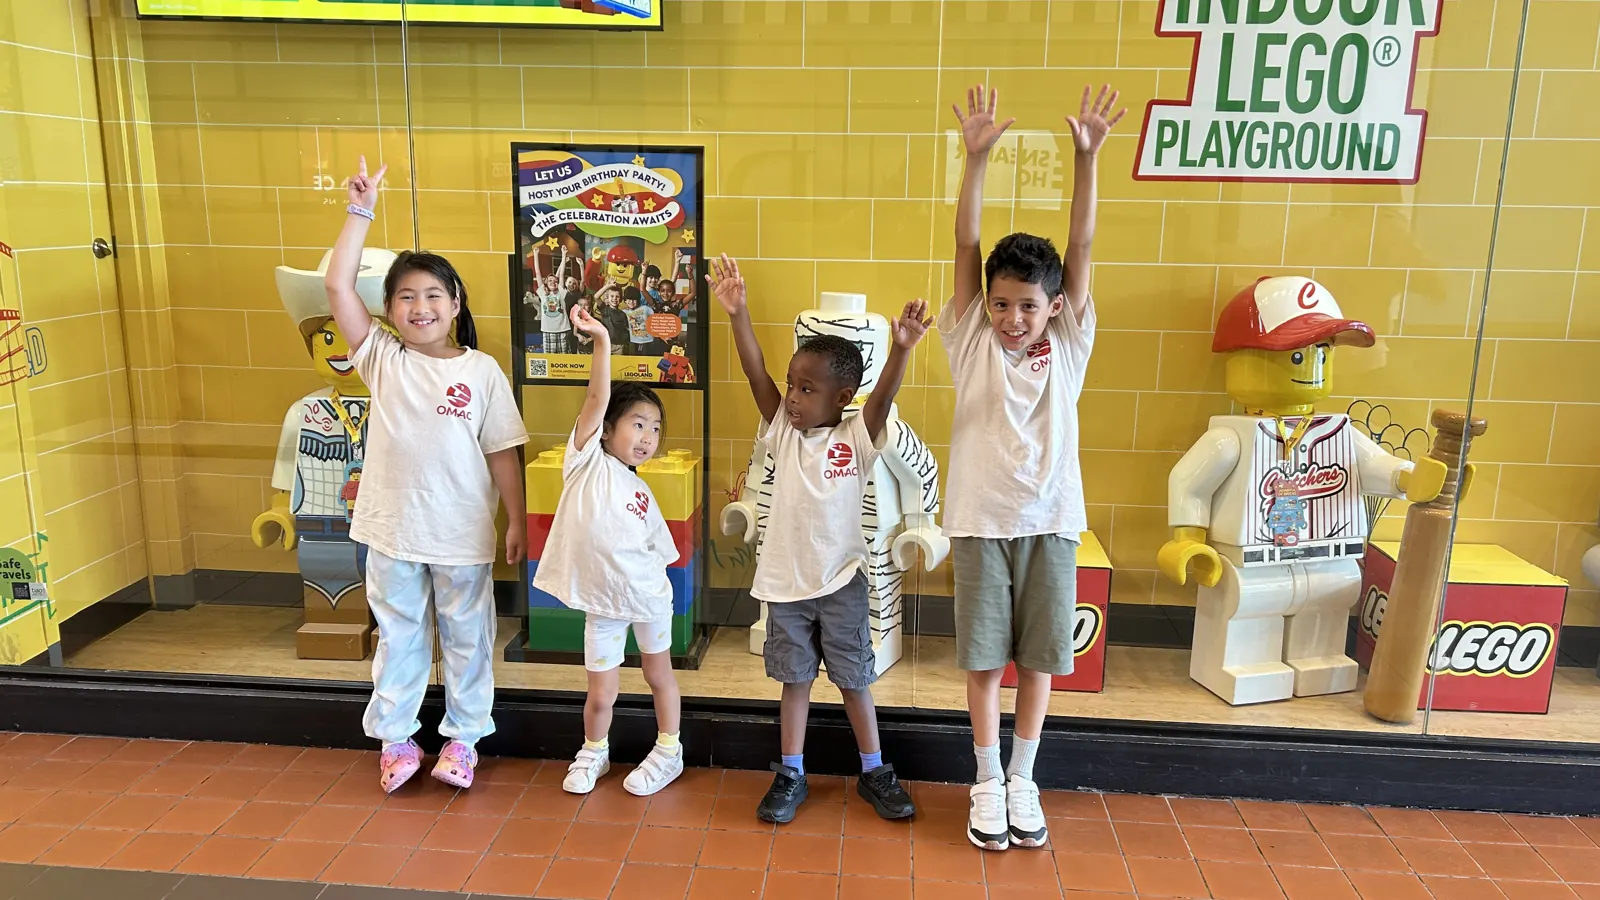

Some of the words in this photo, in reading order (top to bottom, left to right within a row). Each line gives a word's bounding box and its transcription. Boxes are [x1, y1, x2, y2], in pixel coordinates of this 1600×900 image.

[1154, 119, 1400, 171] PLAYGROUND
[535, 169, 555, 181] LET
[557, 165, 572, 177] US
[528, 189, 557, 200] HOST
[556, 182, 582, 197] YOUR
[583, 169, 629, 186] BIRTHDAY
[632, 170, 666, 191] PARTY!
[536, 214, 556, 231] THE
[558, 211, 632, 225] CELEBRATION
[632, 209, 672, 225] AWAITS
[436, 405, 472, 421] OMAC
